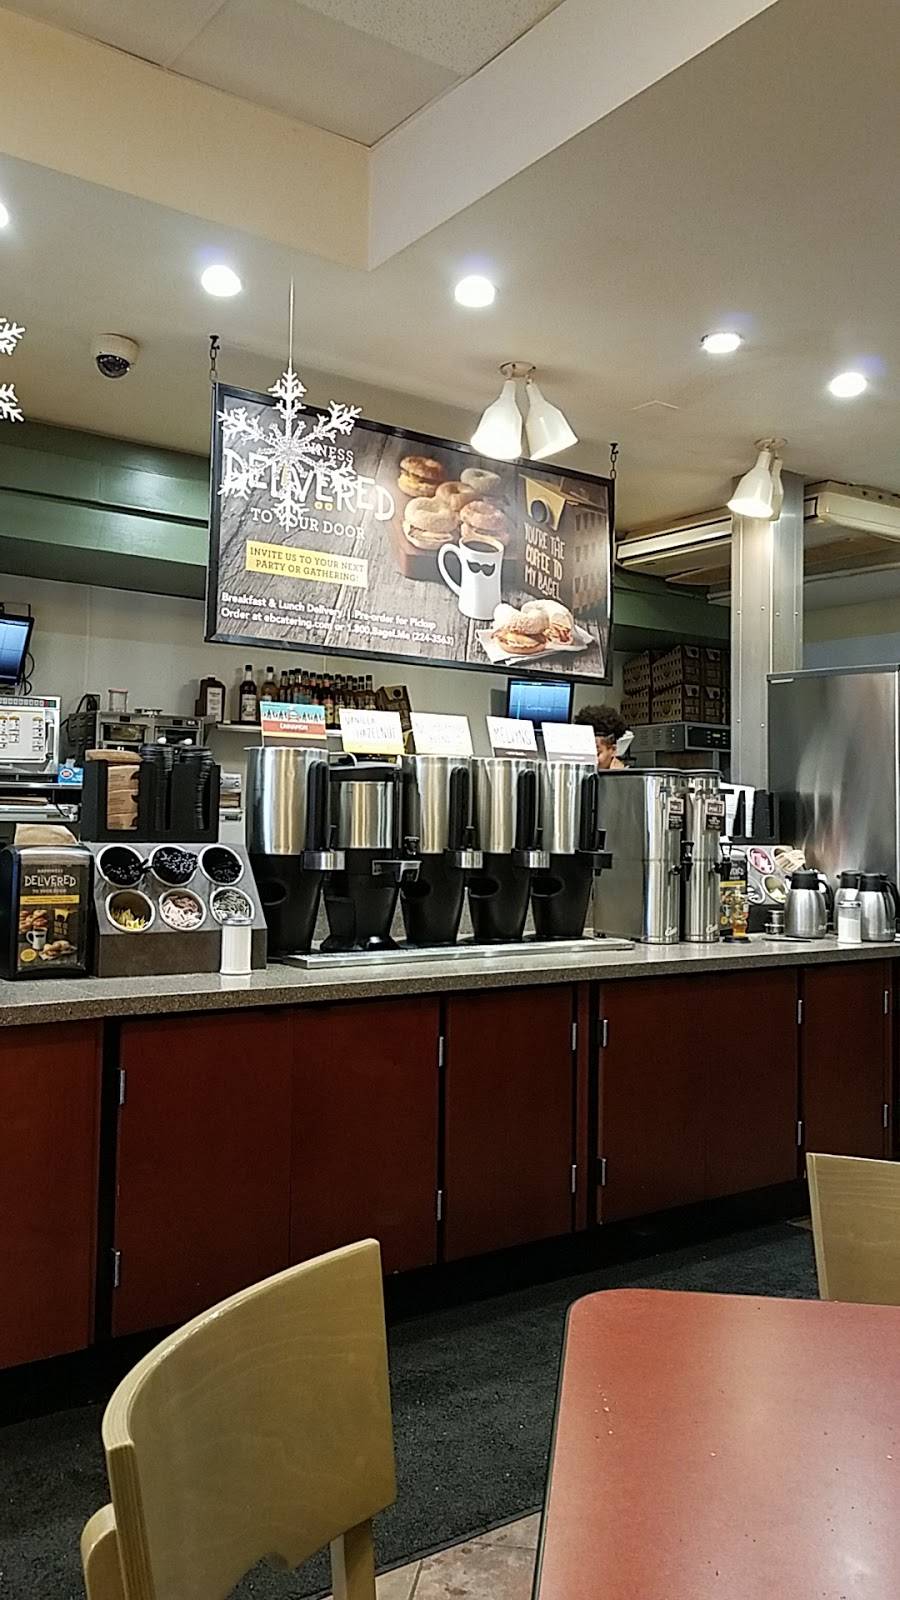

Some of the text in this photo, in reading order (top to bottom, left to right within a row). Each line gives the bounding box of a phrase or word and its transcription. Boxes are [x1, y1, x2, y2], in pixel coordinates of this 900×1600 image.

[221, 447, 396, 521] DELIVERED
[250, 507, 273, 523] TO
[323, 519, 366, 541] DOOR
[250, 547, 365, 573] INVITE US TO YOUR NEXT
[525, 543, 563, 581] COFFEE TO
[550, 536, 566, 560] THE
[255, 559, 286, 572] PARTY
[288, 564, 301, 574] OR
[524, 564, 563, 601] MY BAGEL
[220, 608, 250, 620] Order
[251, 612, 263, 621] at
[264, 613, 334, 630] ebcatering.com
[334, 623, 346, 632] or
[221, 591, 437, 631] Breakfast & Lunch Delivery Pre-order for Pickup
[24, 874, 77, 887] DELIVERED
